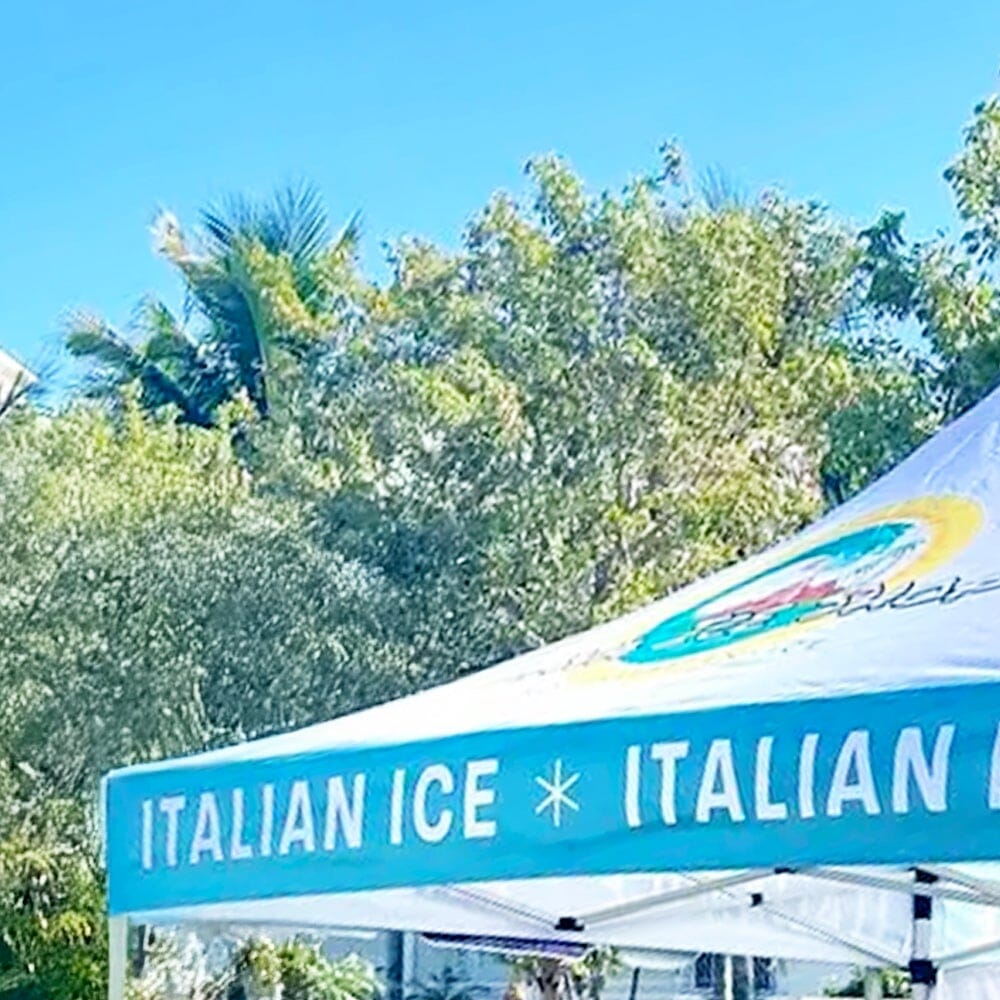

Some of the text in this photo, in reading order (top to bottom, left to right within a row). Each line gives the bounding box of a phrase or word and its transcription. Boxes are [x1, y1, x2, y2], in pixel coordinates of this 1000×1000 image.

[141, 774, 366, 870] ITALIAN
[389, 759, 498, 845] ICE
[624, 724, 956, 828] ITALIAN
